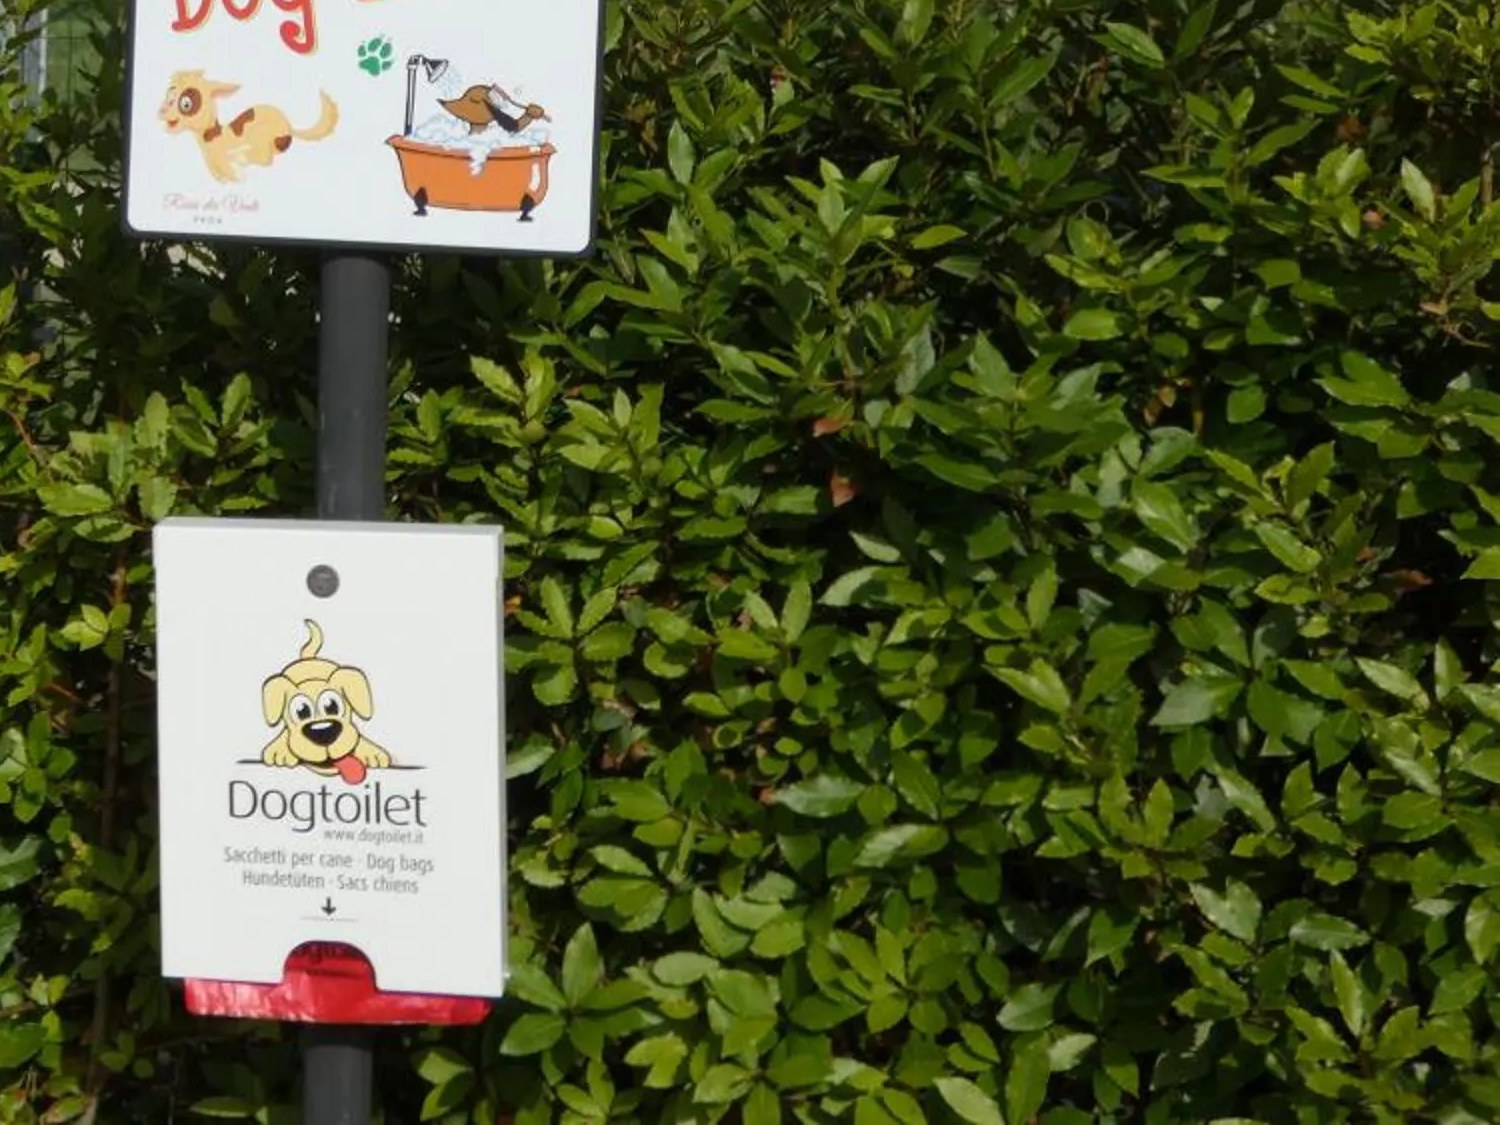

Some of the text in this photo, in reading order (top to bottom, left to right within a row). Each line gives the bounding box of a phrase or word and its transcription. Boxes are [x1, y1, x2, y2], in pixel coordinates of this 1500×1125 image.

[228, 779, 428, 834] Dogtoilet
[323, 828, 425, 845] www.dogtoilet.it
[223, 845, 434, 876] Sacchetti per cane Dog bags
[337, 873, 368, 892] Sacs
[373, 875, 419, 894] chiens
